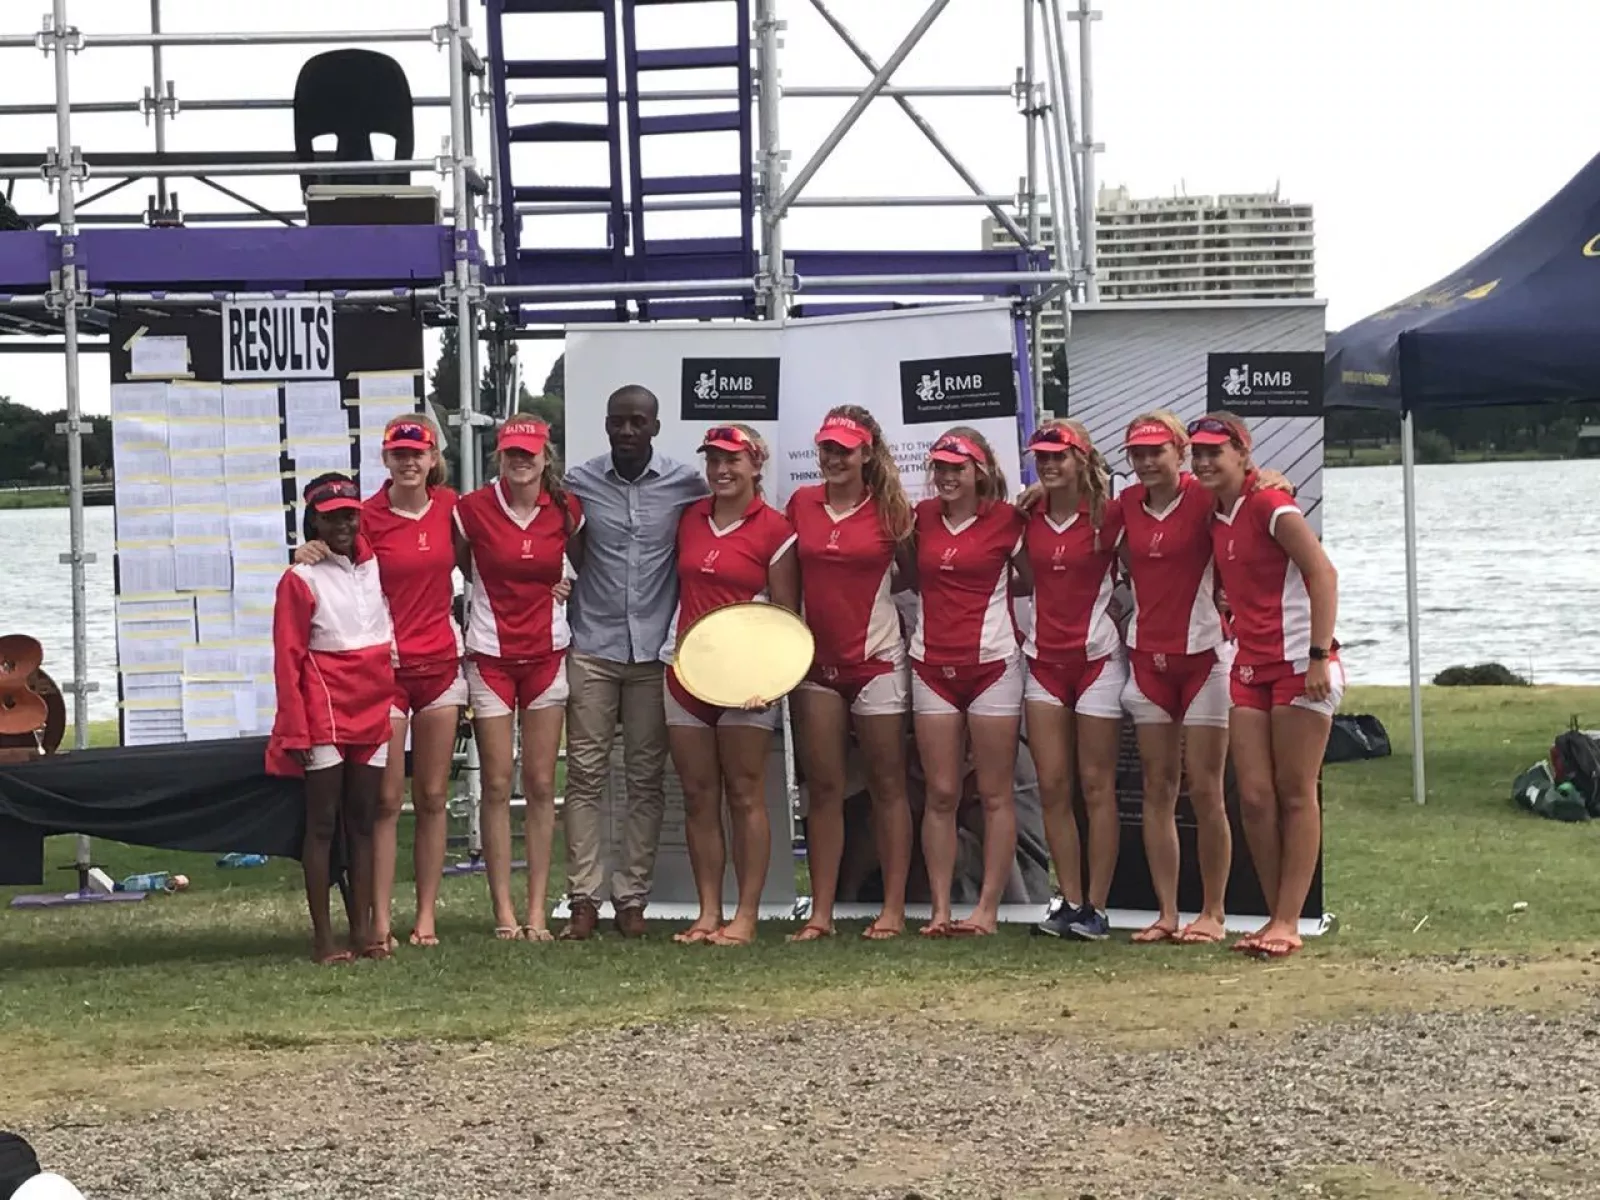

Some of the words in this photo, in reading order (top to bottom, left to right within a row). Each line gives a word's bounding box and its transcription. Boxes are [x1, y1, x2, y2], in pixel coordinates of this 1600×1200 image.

[229, 306, 330, 371] RESULTS
[719, 376, 753, 391] RMB
[944, 374, 982, 391] RMB
[1252, 371, 1292, 386] RMB
[901, 442, 915, 451] TO
